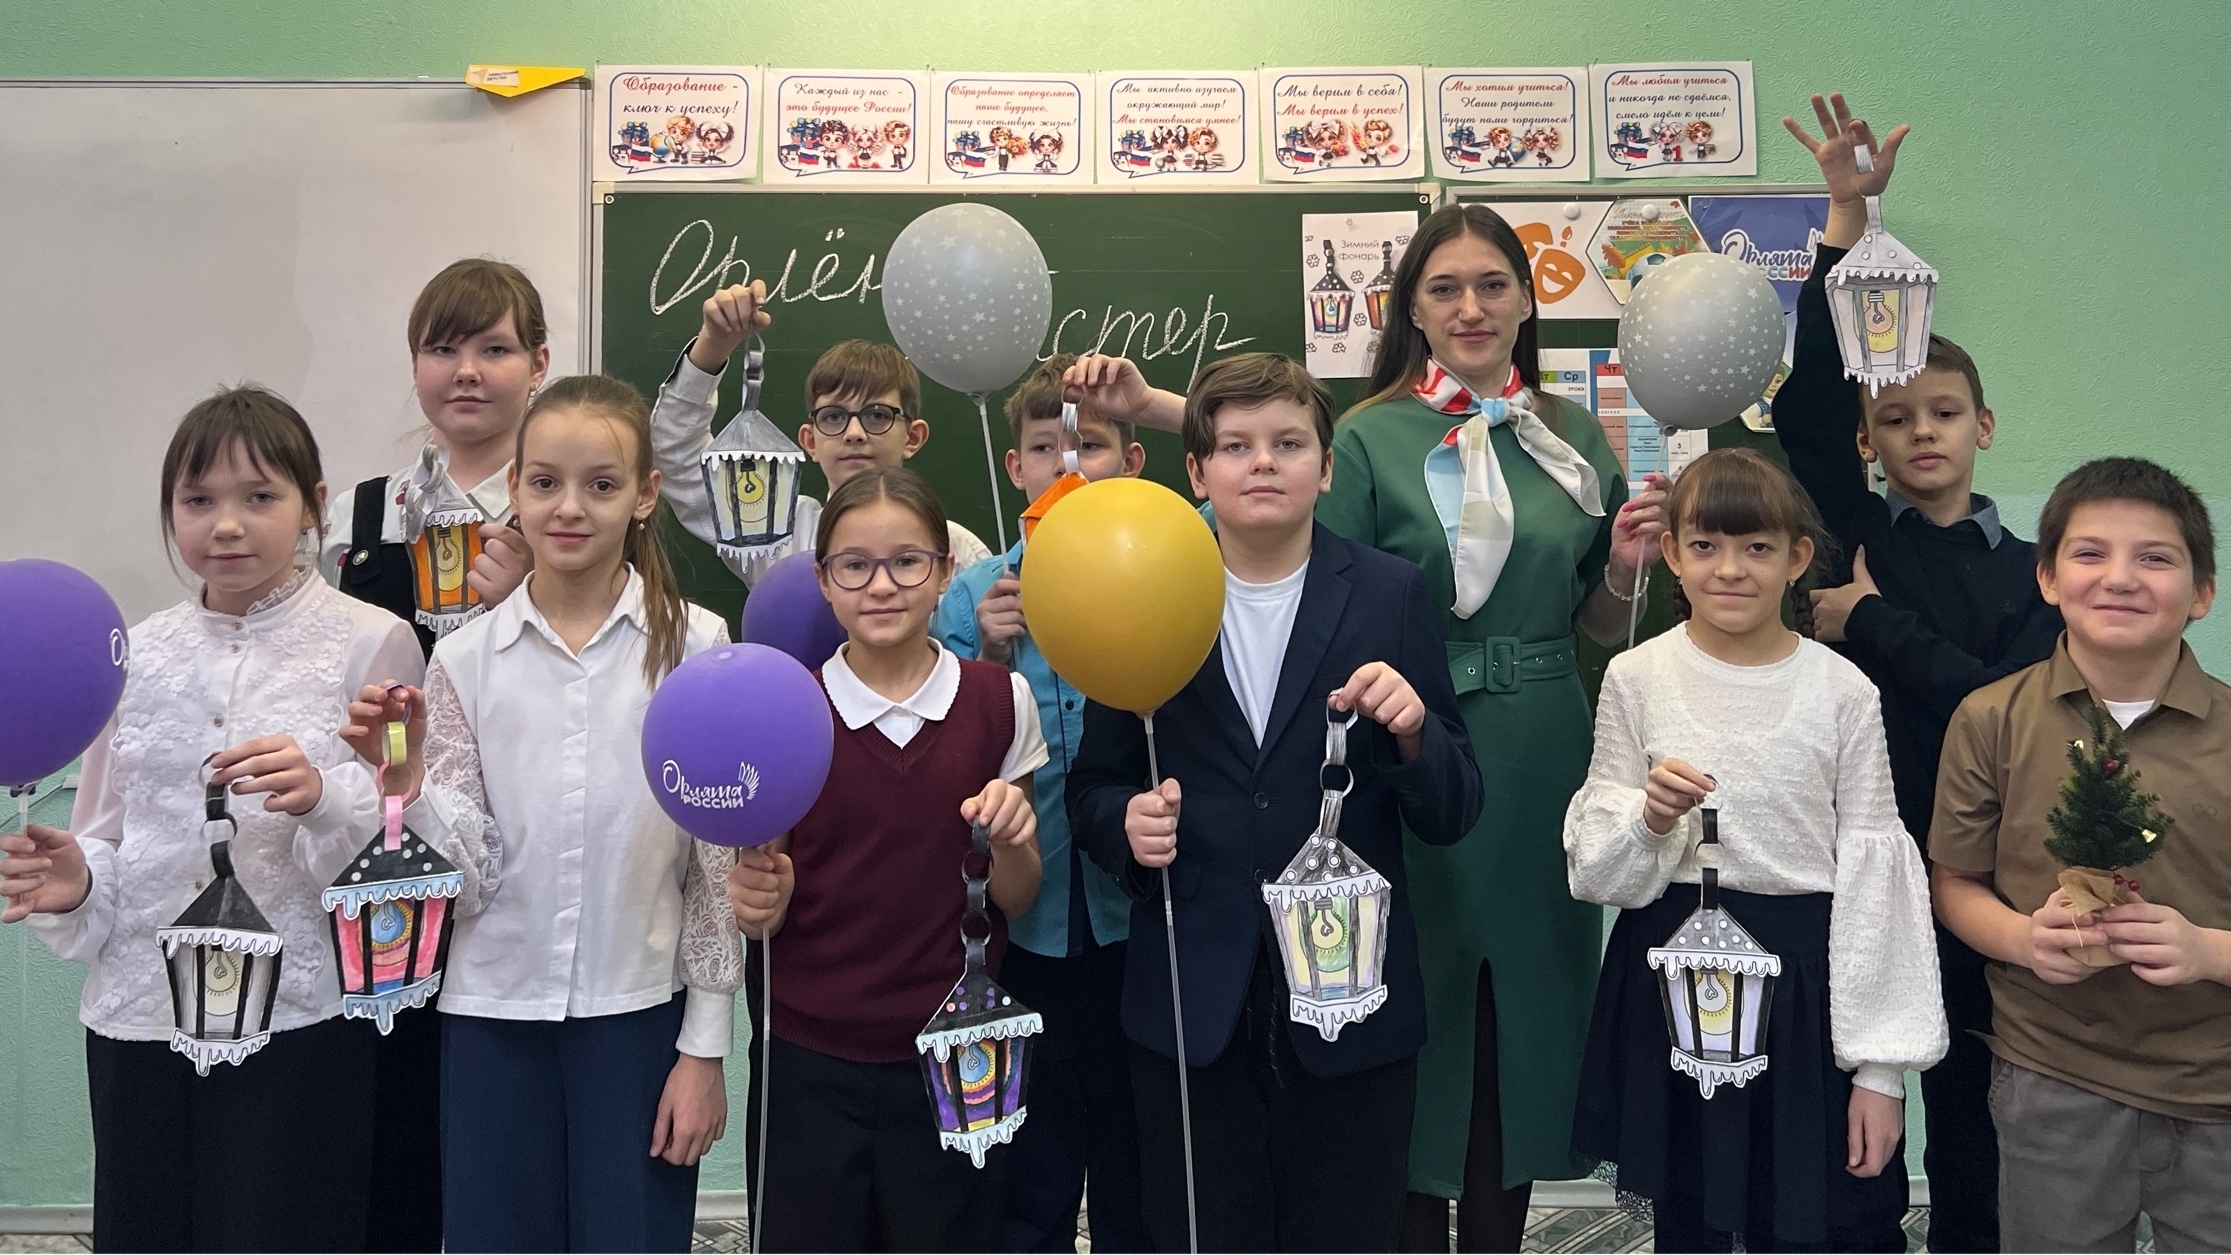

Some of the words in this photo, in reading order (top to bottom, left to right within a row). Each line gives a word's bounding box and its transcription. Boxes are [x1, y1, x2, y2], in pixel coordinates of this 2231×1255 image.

[623, 76, 726, 95] Образование
[1446, 81, 1472, 92] Мы
[1475, 84, 1514, 92] хотим
[1517, 81, 1570, 95] учиться!
[1612, 74, 1639, 86] Мы
[1642, 74, 1681, 86] любим
[1684, 77, 1729, 88] учиться
[795, 83, 850, 98] Каждый
[853, 88, 866, 99] из
[950, 85, 1015, 98] Образование
[1018, 89, 1076, 99] определяет
[1117, 83, 1142, 93] Мы
[1147, 84, 1193, 93] активно
[1195, 87, 1238, 97] изучаем
[1277, 84, 1308, 97] Мы
[1312, 85, 1352, 101] верим
[1356, 84, 1365, 97] в
[1368, 84, 1403, 97] себя!
[1127, 100, 1198, 111] окружающий
[1200, 99, 1227, 111] мир!
[1461, 96, 1498, 108] Наши
[1500, 98, 1555, 111] родители
[1619, 94, 1665, 105] никогда
[1684, 93, 1731, 105] сдаёмся,
[623, 104, 660, 113] ключ
[665, 104, 675, 113] к
[680, 101, 738, 118] успеху!
[812, 101, 860, 115] будущее
[863, 101, 912, 113] России!
[1277, 103, 1306, 116] Мы
[1310, 103, 1348, 119] верим
[1352, 103, 1360, 115] в
[1363, 103, 1404, 119] успех!
[1113, 114, 1137, 124] Мы
[1139, 114, 1202, 124] становимся
[1205, 115, 1242, 128] умнее!
[1442, 113, 1476, 127] будут
[1512, 113, 1574, 127] гордиться!
[1616, 111, 1650, 119] смело
[1653, 110, 1682, 124] идём
[1695, 107, 1726, 119] цели!
[947, 118, 974, 128] нашу
[976, 116, 1036, 129] счастливую
[1039, 118, 1077, 130] жизнь!
[1672, 145, 1683, 162] 1
[1340, 239, 1380, 249] Зимний
[1722, 230, 1813, 267] Орлята
[1338, 252, 1380, 262] фонарь
[1563, 371, 1579, 382] Ср
[1604, 365, 1618, 374] Чт
[662, 759, 743, 800] Орлята
[683, 795, 744, 809] РОССИИ
